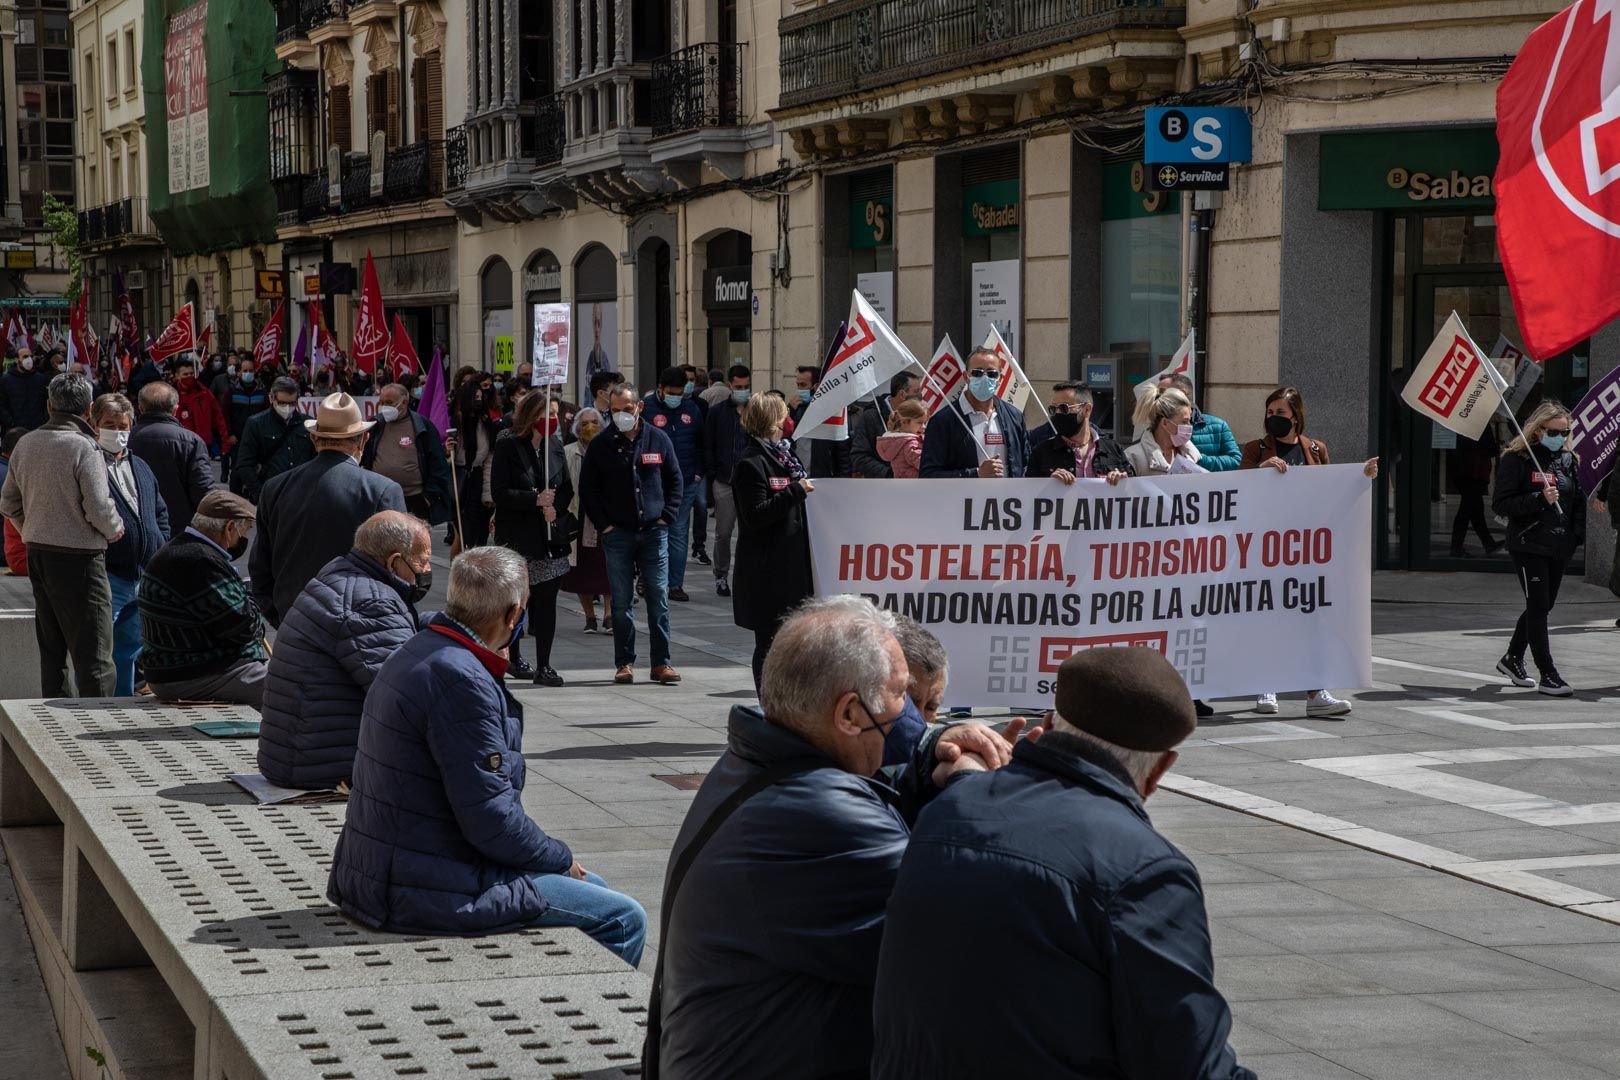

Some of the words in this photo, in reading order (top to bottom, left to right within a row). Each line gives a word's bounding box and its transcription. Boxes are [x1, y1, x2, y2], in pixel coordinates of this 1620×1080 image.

[1168, 117, 1181, 135] B
[1191, 117, 1222, 160] S
[1180, 171, 1224, 182] ServiRed
[1408, 170, 1497, 200] Saba
[978, 203, 1019, 228] Sabadell
[715, 275, 749, 302] flormar
[841, 371, 849, 383] y
[848, 354, 876, 376] León
[1425, 343, 1475, 411] CCOO
[1459, 388, 1481, 418] Castilla
[964, 498, 1021, 531] LAS
[1033, 492, 1200, 531] PLANTILLAS
[1208, 489, 1238, 523] DE
[839, 535, 1077, 588] HOSTELERÍA,
[1090, 535, 1226, 581] TURISMO
[1236, 532, 1253, 569] Y
[1262, 527, 1332, 568] OCIO
[842, 592, 1081, 626] ANDONADAS
[1090, 590, 1144, 625] POR
[1152, 587, 1183, 620] LA
[1191, 579, 1274, 617] JUNTA
[1283, 576, 1332, 613] CyL
